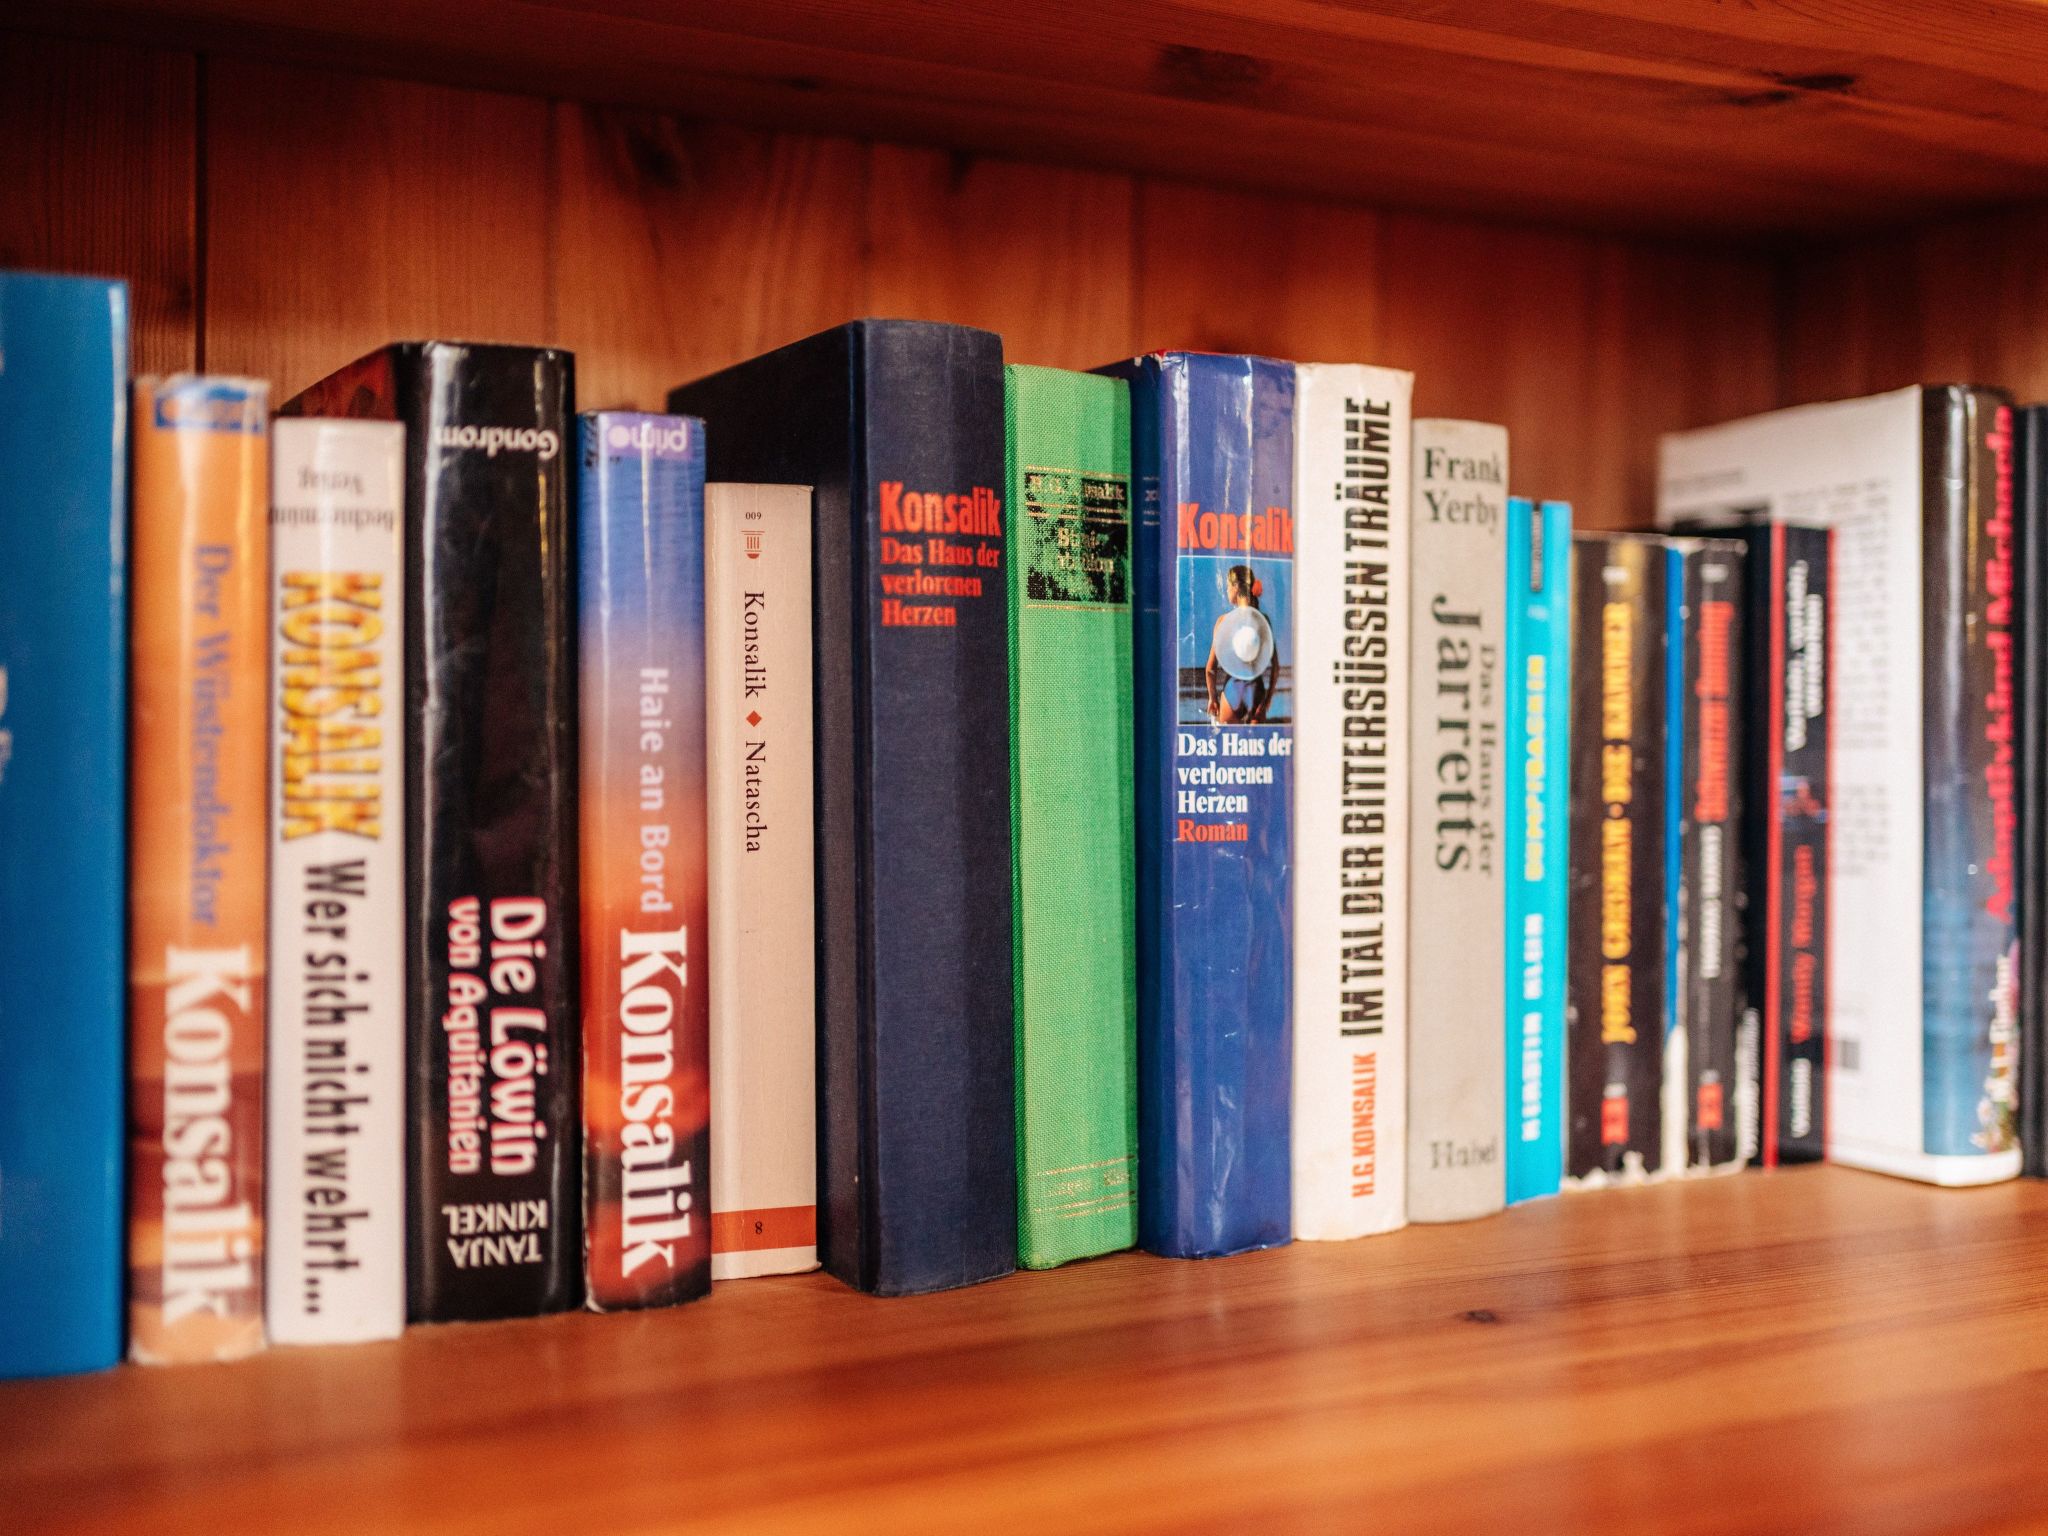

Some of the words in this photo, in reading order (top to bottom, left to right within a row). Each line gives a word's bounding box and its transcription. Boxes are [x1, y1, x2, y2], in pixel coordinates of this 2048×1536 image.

[434, 424, 560, 461] Gondrom
[1334, 397, 1391, 552] TRÄUME
[879, 481, 1001, 537] Konsalik
[1177, 502, 1294, 553] Konsalik
[194, 544, 233, 618] Der
[880, 537, 924, 566] Das
[927, 540, 973, 567] Haus
[976, 542, 1000, 568] der
[881, 571, 983, 598] verlorenen
[744, 590, 767, 699] Konsalik
[881, 600, 957, 627] Herzen
[280, 571, 384, 843] KONSALIK
[640, 667, 673, 753] Haie
[1333, 561, 1390, 836] BITTERSÜSSEN
[1431, 594, 1482, 873] Jarretts
[1177, 732, 1218, 757] Das
[1221, 732, 1264, 757] Haus
[1267, 731, 1293, 757] der
[1177, 761, 1273, 785] verlorenen
[640, 759, 670, 812] an
[745, 740, 768, 854] Natascha
[1177, 789, 1248, 814] Herzen
[1177, 818, 1248, 843] Roman
[303, 857, 366, 942] Wer
[640, 825, 673, 913] Bord
[1340, 843, 1386, 916] DER
[448, 896, 481, 969] von
[490, 897, 548, 995] Die
[1340, 921, 1385, 984] TAL
[303, 951, 371, 1027] sich
[1339, 988, 1385, 1038] IM
[303, 1037, 371, 1136] nicht
[443, 972, 488, 1175] Aquitanien
[490, 1006, 548, 1176] Löwin
[620, 925, 691, 1278] Konsalik
[162, 944, 254, 1325] Konsalik
[303, 1148, 371, 1315] wehrt...
[442, 1200, 548, 1235] KINKEL
[447, 1236, 543, 1268] TANJA
